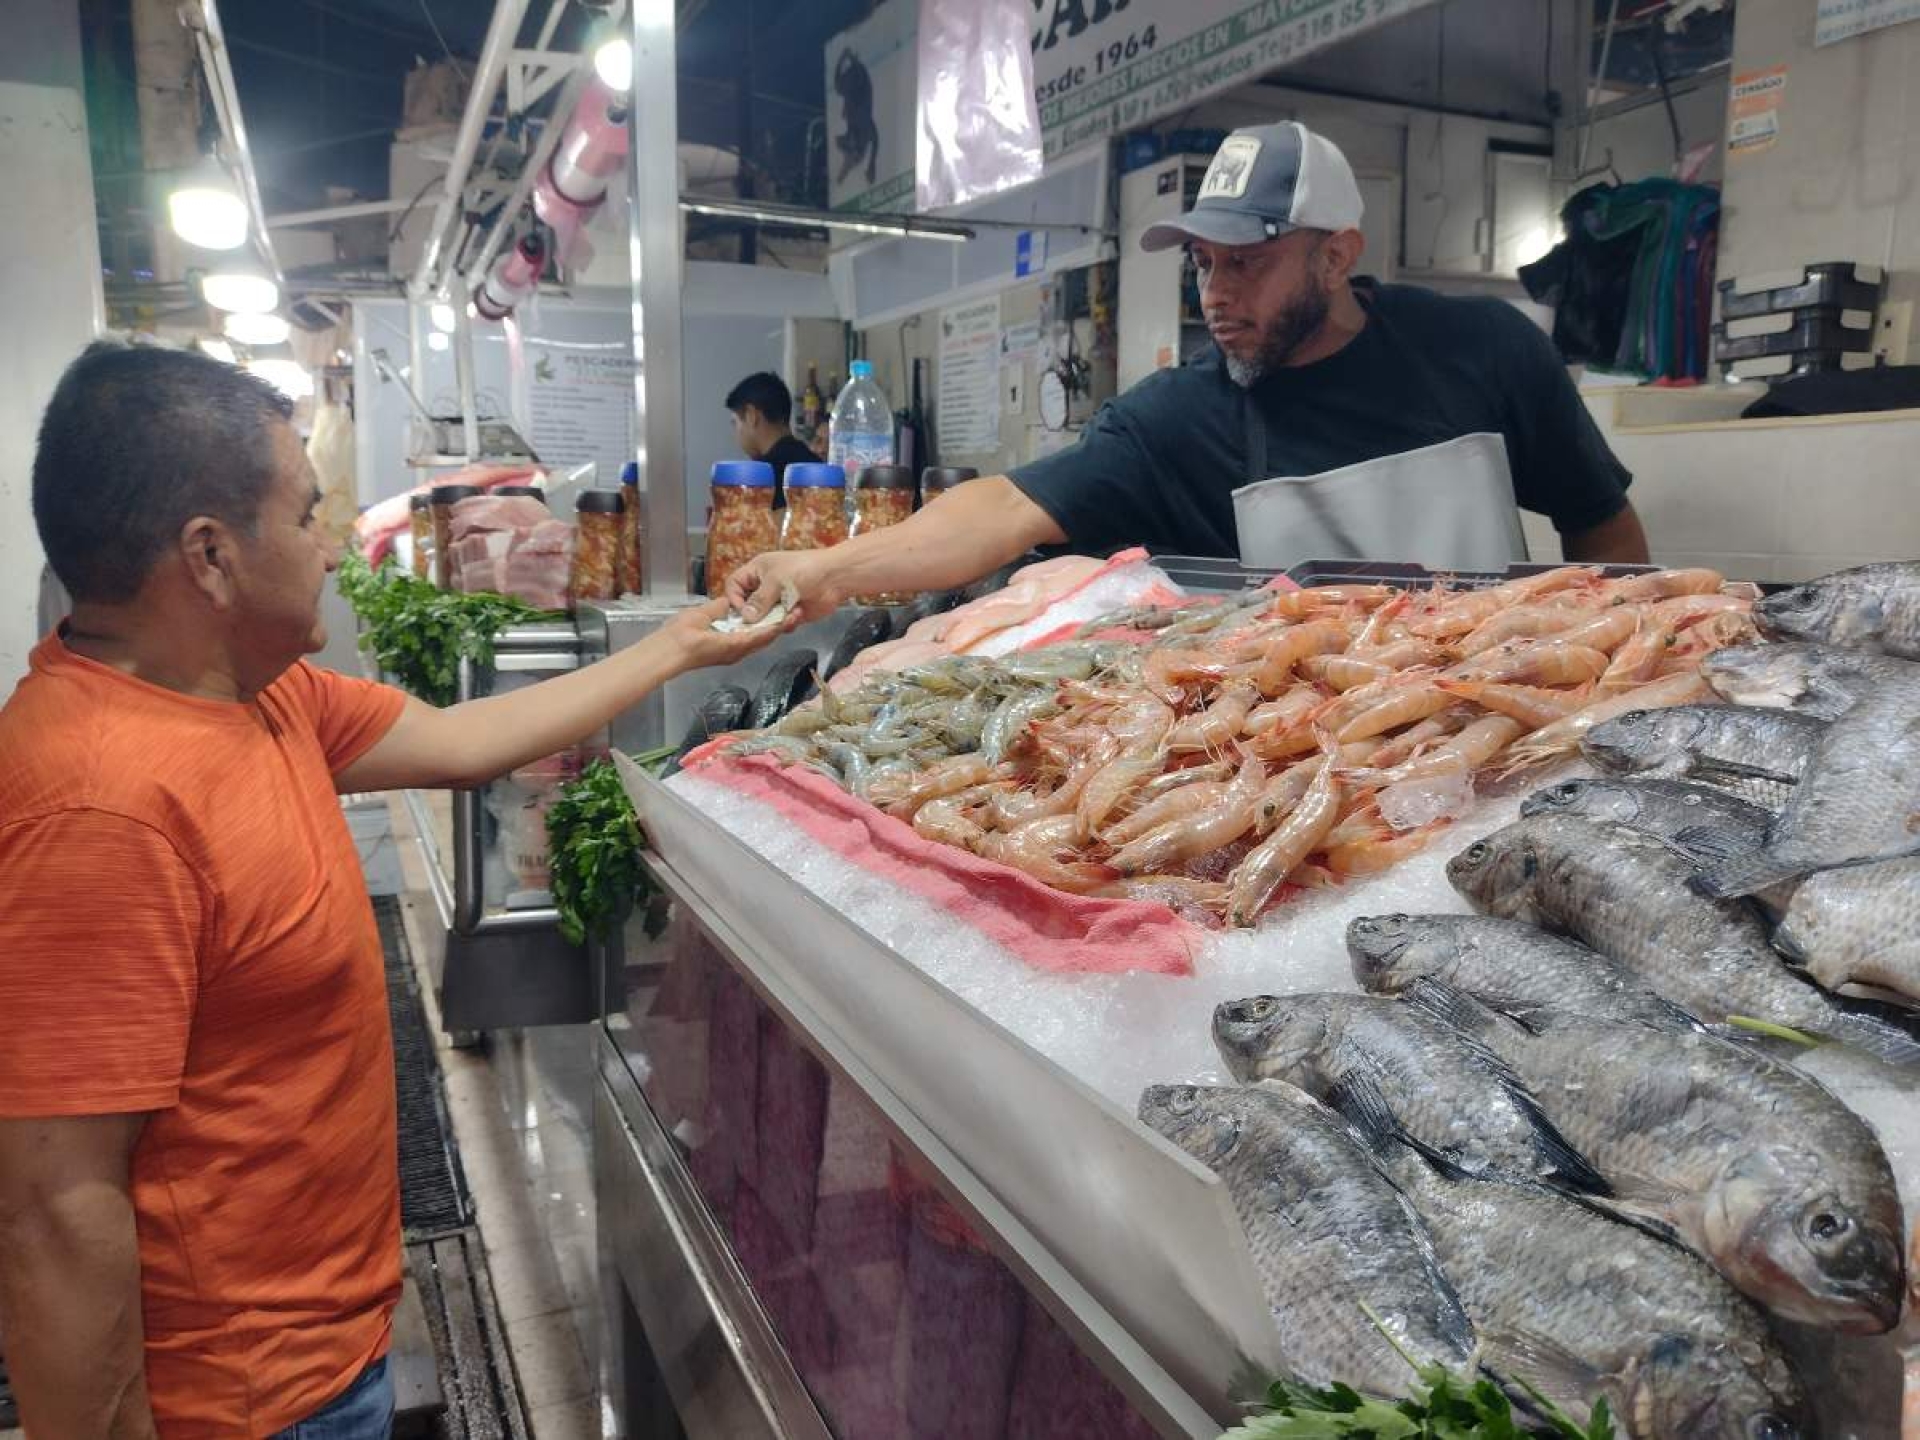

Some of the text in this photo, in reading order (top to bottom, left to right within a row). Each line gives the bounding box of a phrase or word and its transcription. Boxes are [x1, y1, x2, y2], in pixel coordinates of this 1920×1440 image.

[1035, 24, 1158, 101] esde 1964
[1042, 106, 1059, 127] OS
[1130, 44, 1200, 88] PRECIOS
[1203, 23, 1231, 49] EN
